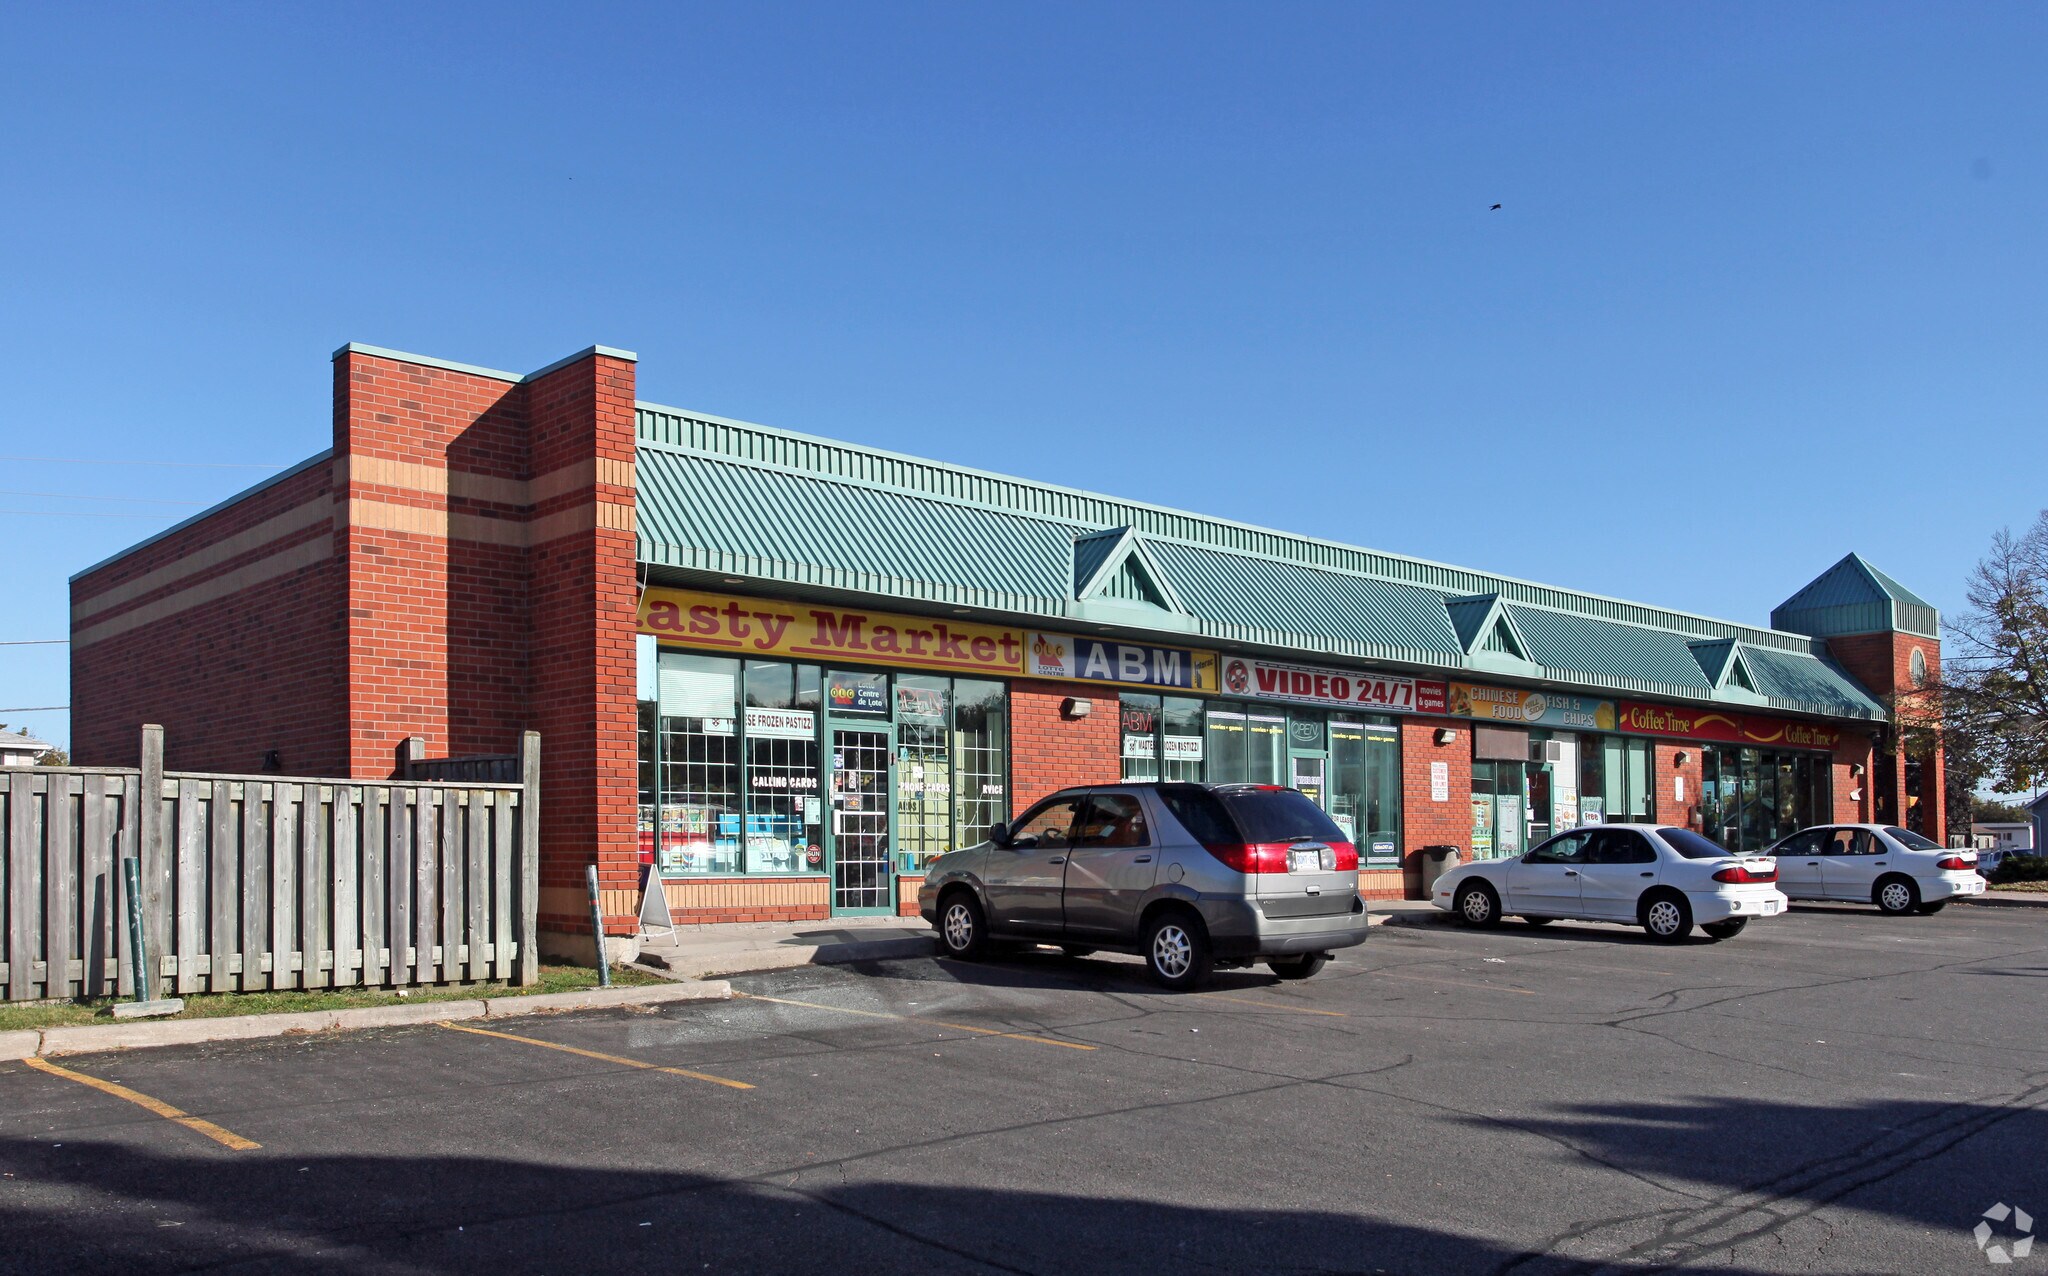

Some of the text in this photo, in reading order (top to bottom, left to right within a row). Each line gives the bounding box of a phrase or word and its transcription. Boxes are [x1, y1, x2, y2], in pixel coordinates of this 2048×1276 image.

[636, 601, 1021, 664] asty Market
[1034, 644, 1063, 656] OLG
[1084, 642, 1181, 686] ABM
[858, 681, 874, 689] Lotto
[1255, 667, 1413, 706] VIDEO 24/7
[1420, 685, 1442, 696] movies
[831, 688, 854, 698] OLG
[858, 690, 879, 698] Centre
[1470, 687, 1519, 704] CHINESE
[868, 698, 882, 707] Loto
[897, 690, 944, 714] PEN
[1418, 698, 1444, 708] & games
[1525, 698, 1540, 710] HILL
[1546, 695, 1581, 710] FISH &
[1492, 704, 1522, 720] FOOD
[1529, 704, 1544, 715] SIDE
[758, 715, 784, 728] FROZEN
[786, 716, 813, 730] PASTIZZI
[1122, 711, 1153, 733] ABM
[1563, 712, 1595, 726] CHIPS
[1631, 707, 1690, 733] Coffee Time
[1292, 722, 1319, 736] OPEN
[1785, 724, 1831, 746] Coffee Time
[752, 776, 817, 789] CALLING CARDS
[900, 782, 950, 793] PHONE CARDS
[1339, 816, 1353, 824] LEASE
[1584, 812, 1599, 821] Free
